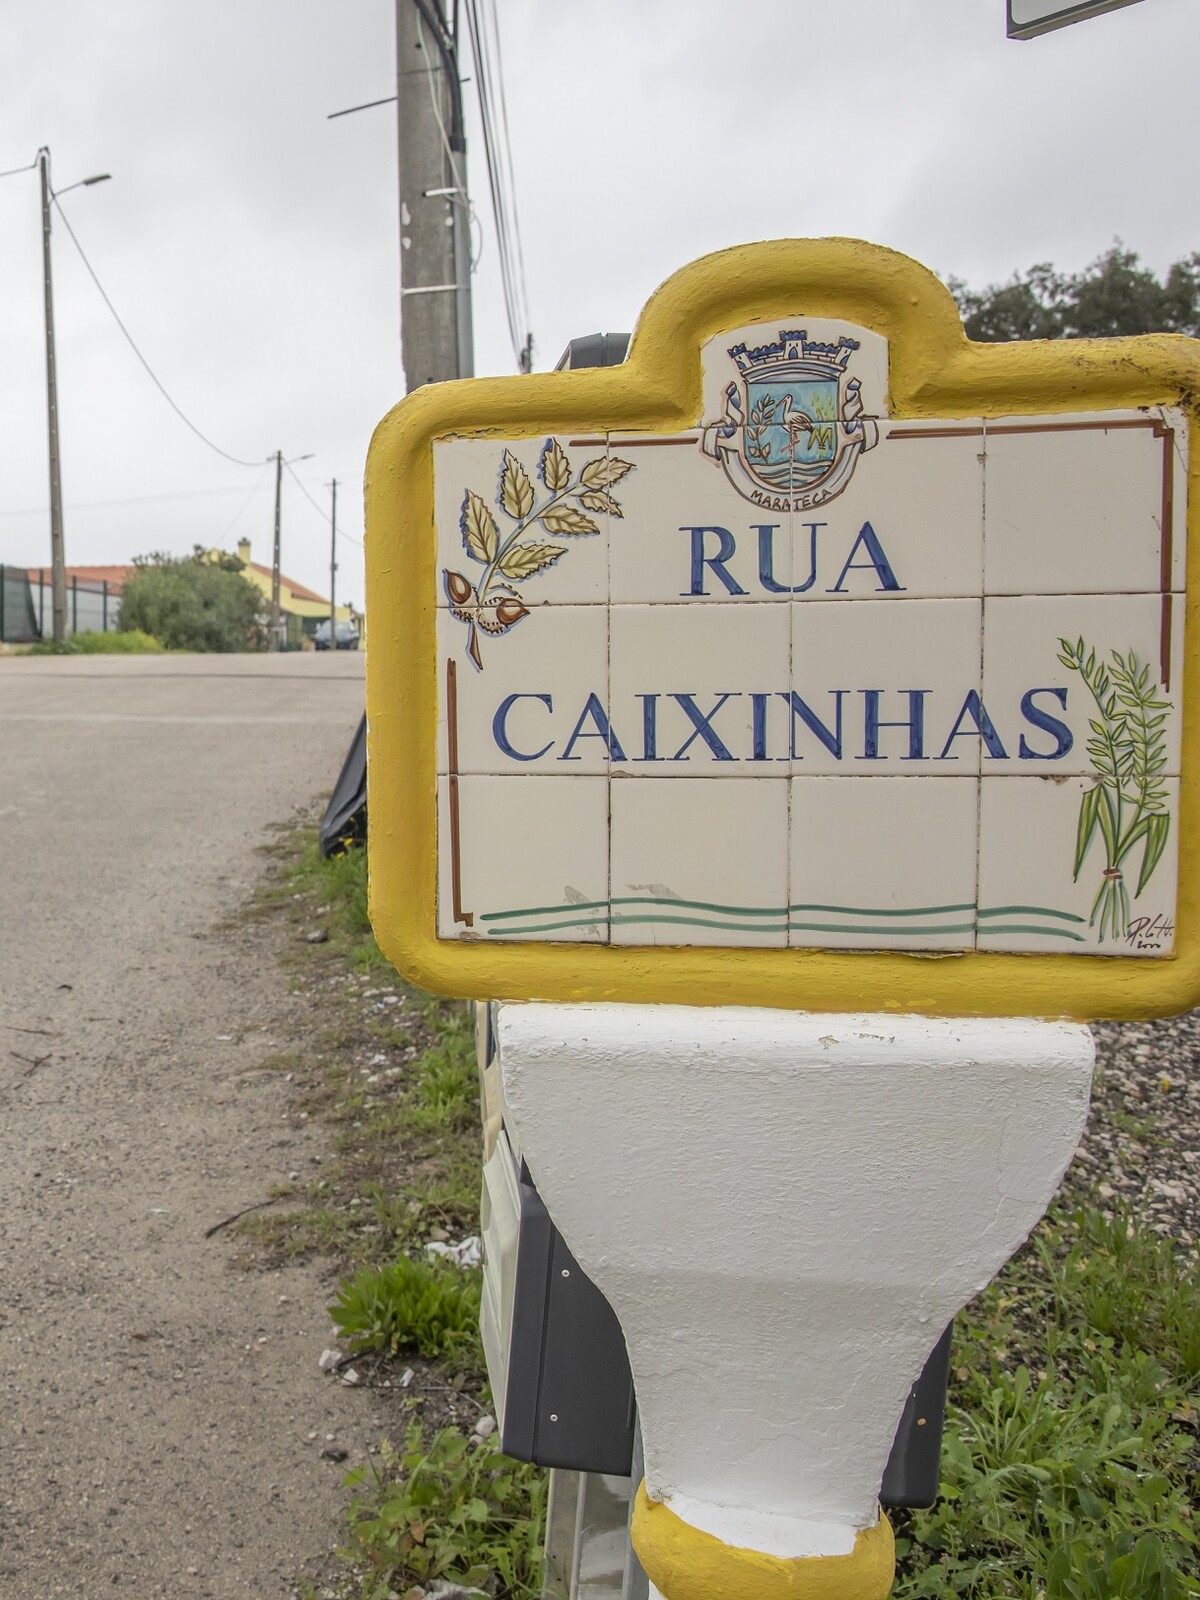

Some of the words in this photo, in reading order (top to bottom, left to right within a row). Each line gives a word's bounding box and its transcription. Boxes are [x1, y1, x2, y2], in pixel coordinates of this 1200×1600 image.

[750, 489, 832, 511] MARATECA
[679, 521, 907, 597] RUA
[492, 687, 1074, 762] CAIXINHAS
